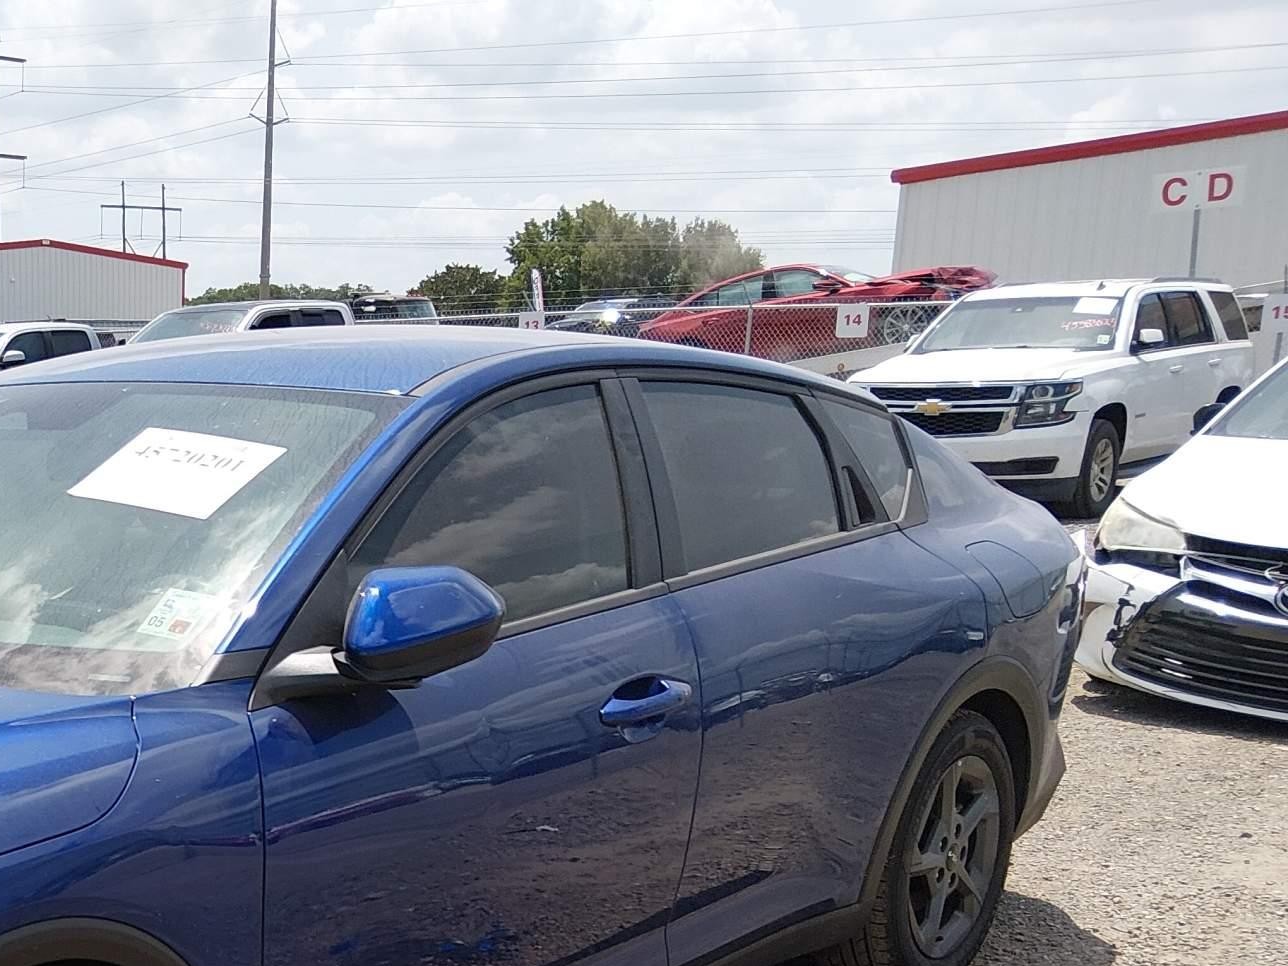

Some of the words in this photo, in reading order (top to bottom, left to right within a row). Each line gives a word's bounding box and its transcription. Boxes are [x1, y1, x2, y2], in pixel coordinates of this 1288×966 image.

[1162, 177, 1188, 206] C
[1207, 172, 1233, 202] D
[524, 320, 540, 330] 13
[843, 314, 863, 327] 14
